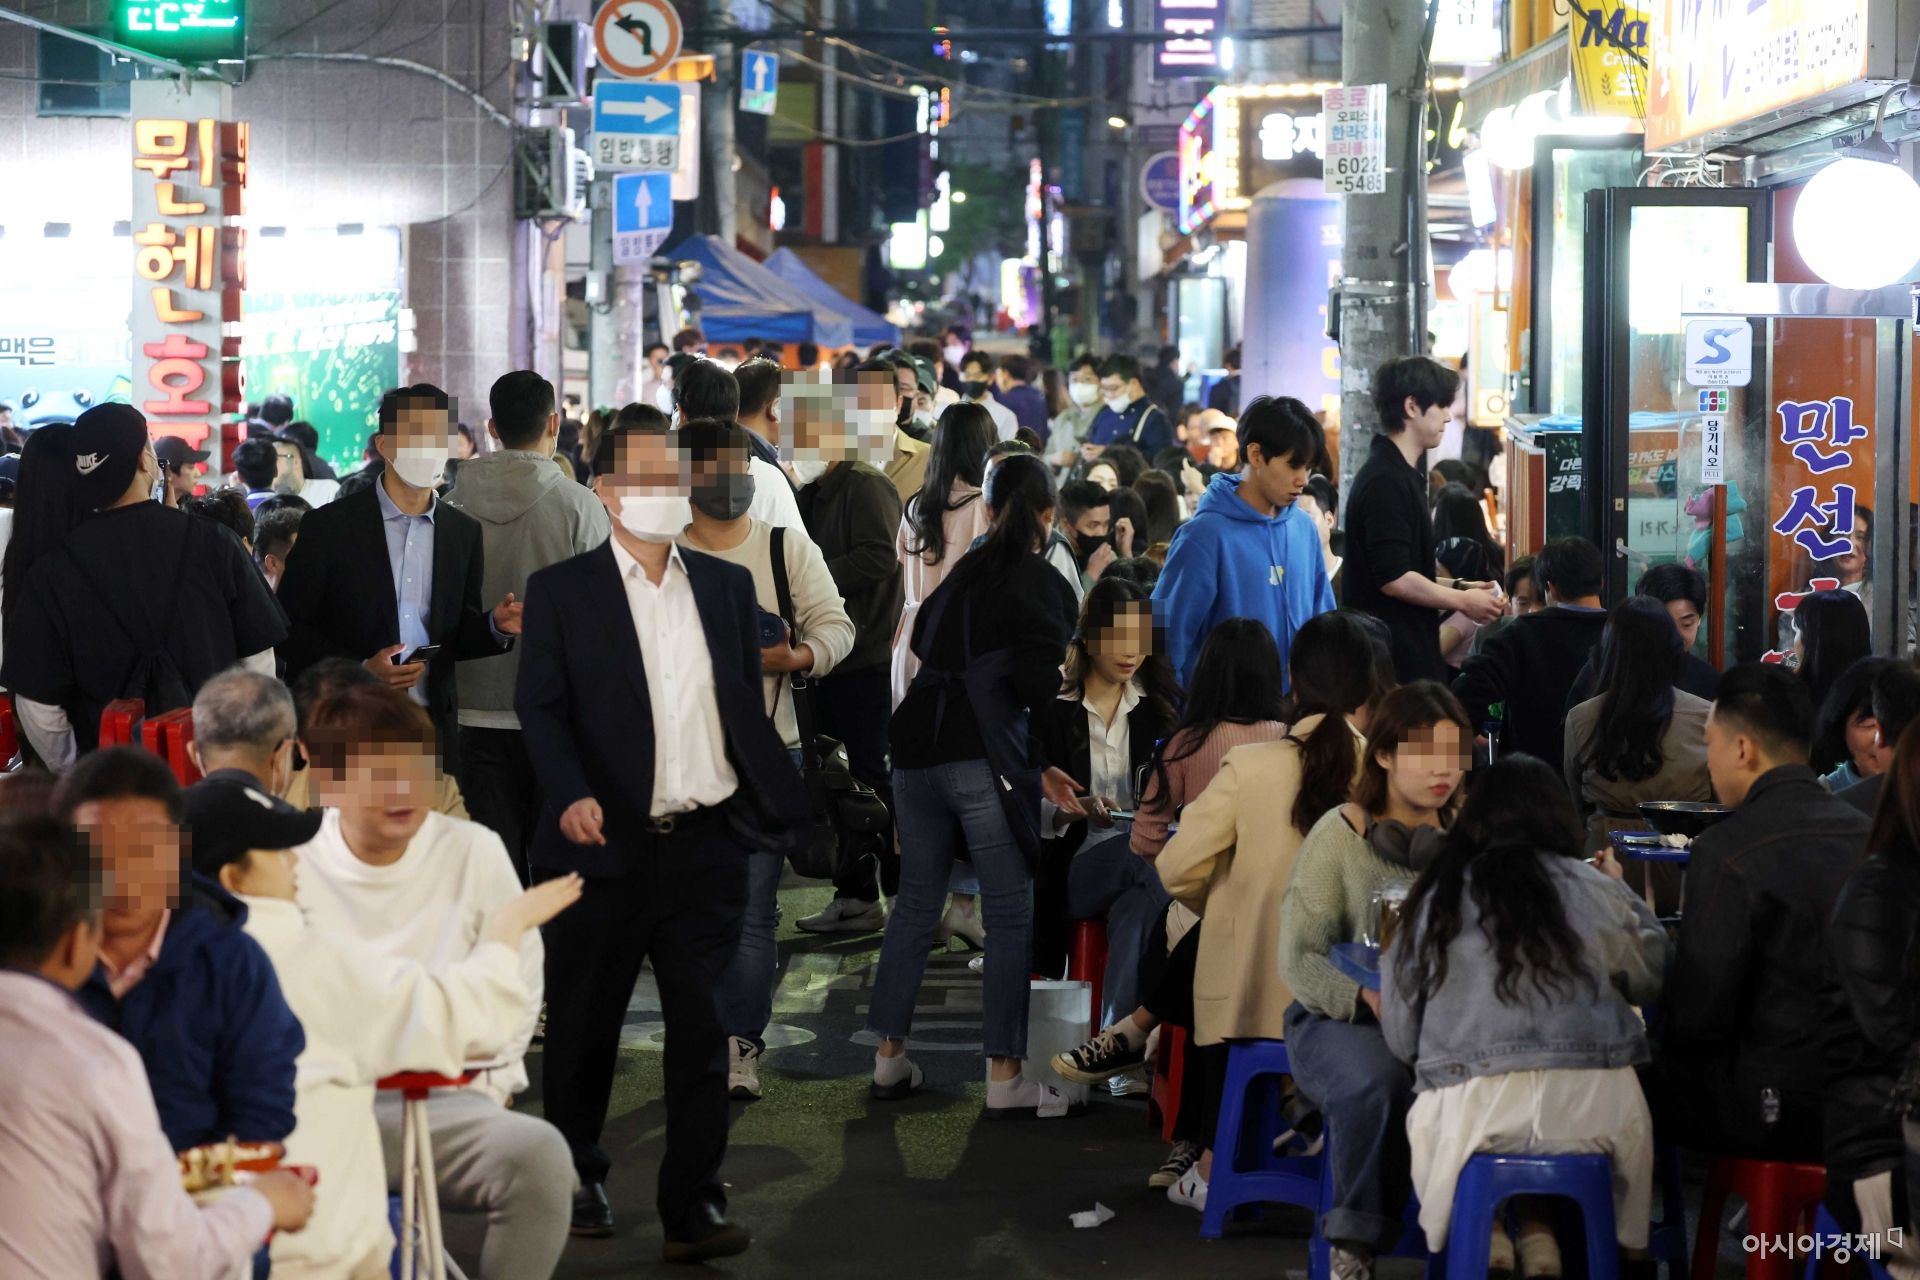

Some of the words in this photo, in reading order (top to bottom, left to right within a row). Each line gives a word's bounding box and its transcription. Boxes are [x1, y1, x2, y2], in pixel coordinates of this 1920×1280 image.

[1580, 9, 1648, 48] Ma
[1337, 110, 1378, 122] 오피스
[600, 138, 672, 166] 일방통행
[1338, 156, 1378, 175] 6022
[1707, 420, 1719, 467] 당기시오
